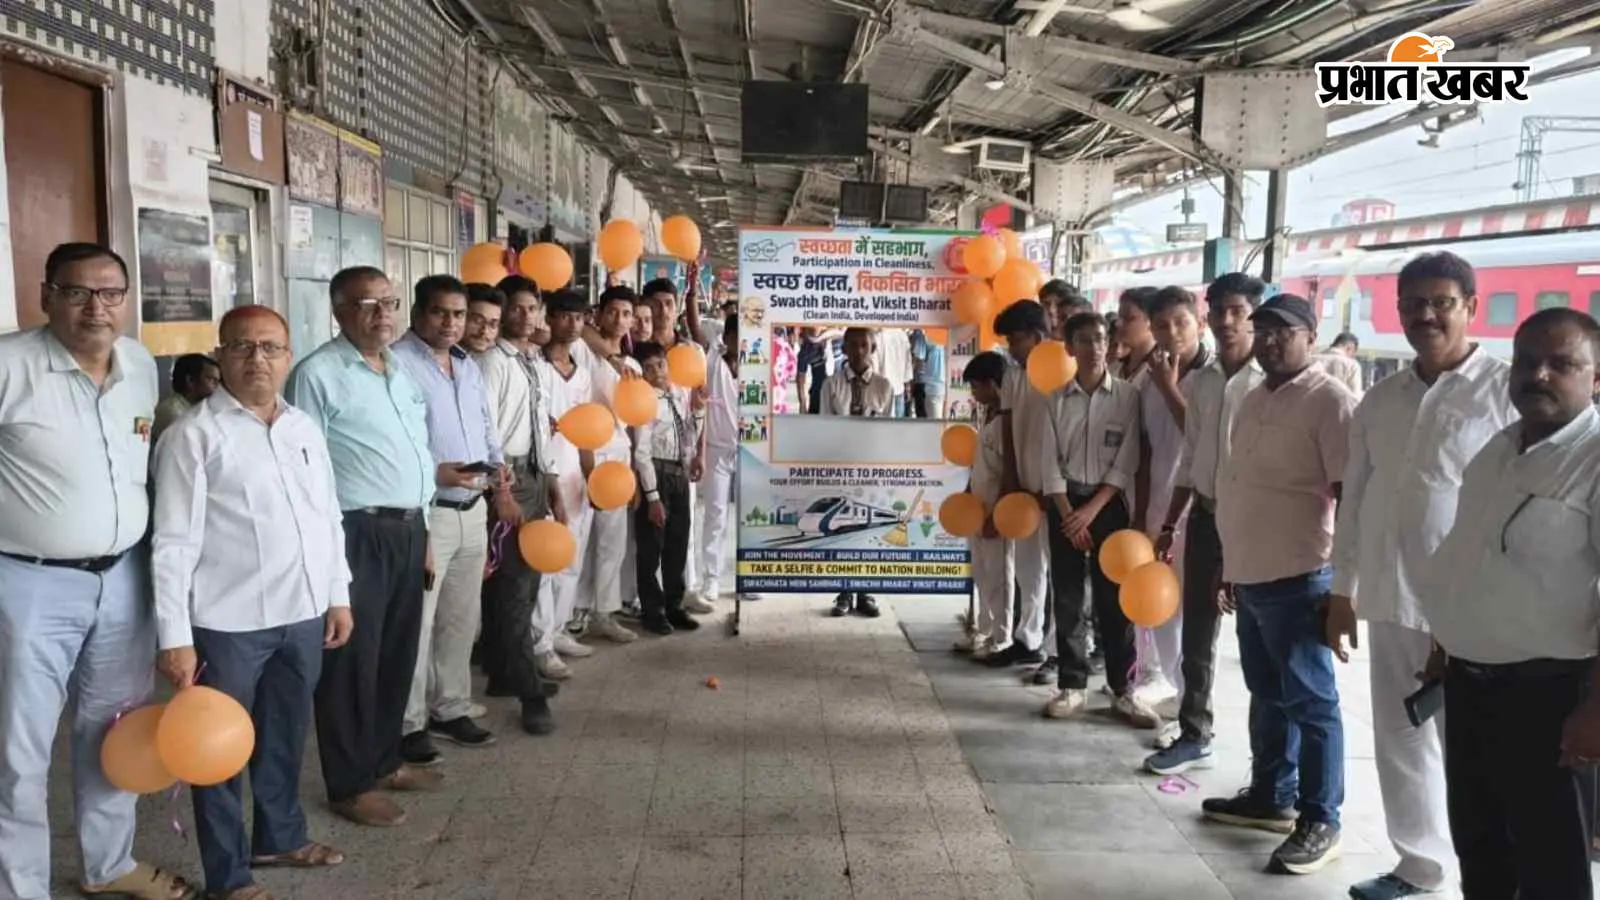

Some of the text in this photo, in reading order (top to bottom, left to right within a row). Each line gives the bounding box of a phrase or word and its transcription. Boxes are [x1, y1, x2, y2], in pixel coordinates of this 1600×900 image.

[798, 236, 928, 258] स्वच्छता में सहभाग,
[793, 256, 935, 270] Participation in Cleanliness.
[752, 273, 801, 290] स्वच्छ
[804, 274, 853, 293] भारत,
[857, 271, 920, 292] विकसित
[770, 295, 951, 310] Swachh Bharat, Viksit Bharat
[803, 311, 829, 320] (Clean
[854, 312, 895, 321] Developed
[897, 313, 919, 321] India)
[789, 467, 926, 478] PARTICIPATE TO PROGRESS.
[744, 551, 761, 559] JOIN
[764, 551, 778, 559] THE
[781, 551, 825, 559] MOVEMENT
[923, 552, 965, 560] RAILWAYS
[751, 564, 961, 575] TAKE A SELFIE & COMMIT TO NATION BUILDING!
